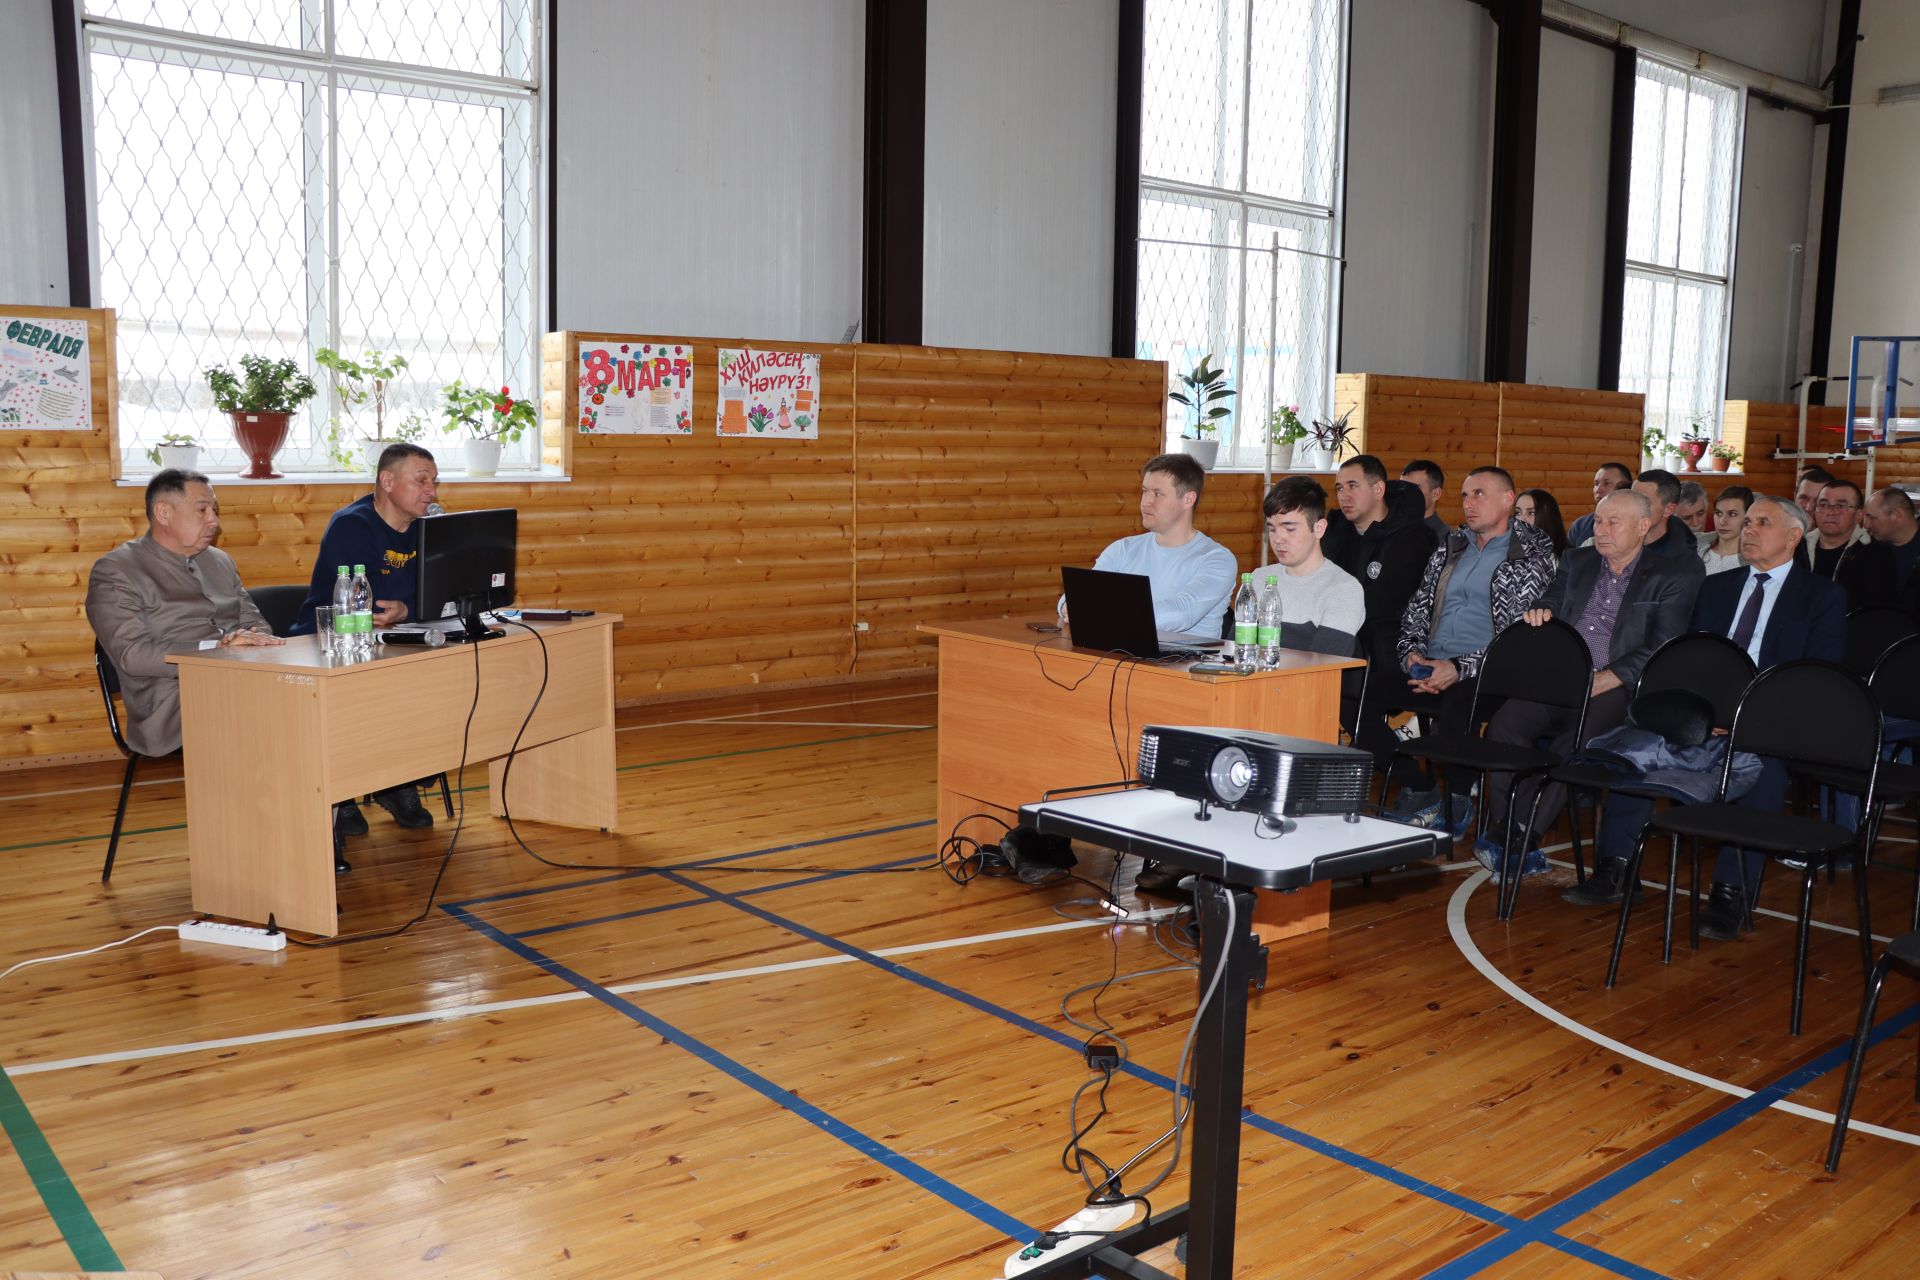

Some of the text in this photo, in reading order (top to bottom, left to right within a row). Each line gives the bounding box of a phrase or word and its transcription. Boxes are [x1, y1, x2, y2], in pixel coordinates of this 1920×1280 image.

[7, 320, 84, 359] ФЕВРАЛЯ
[584, 349, 691, 391] 8 МАРТ
[720, 348, 751, 386] ХУШ
